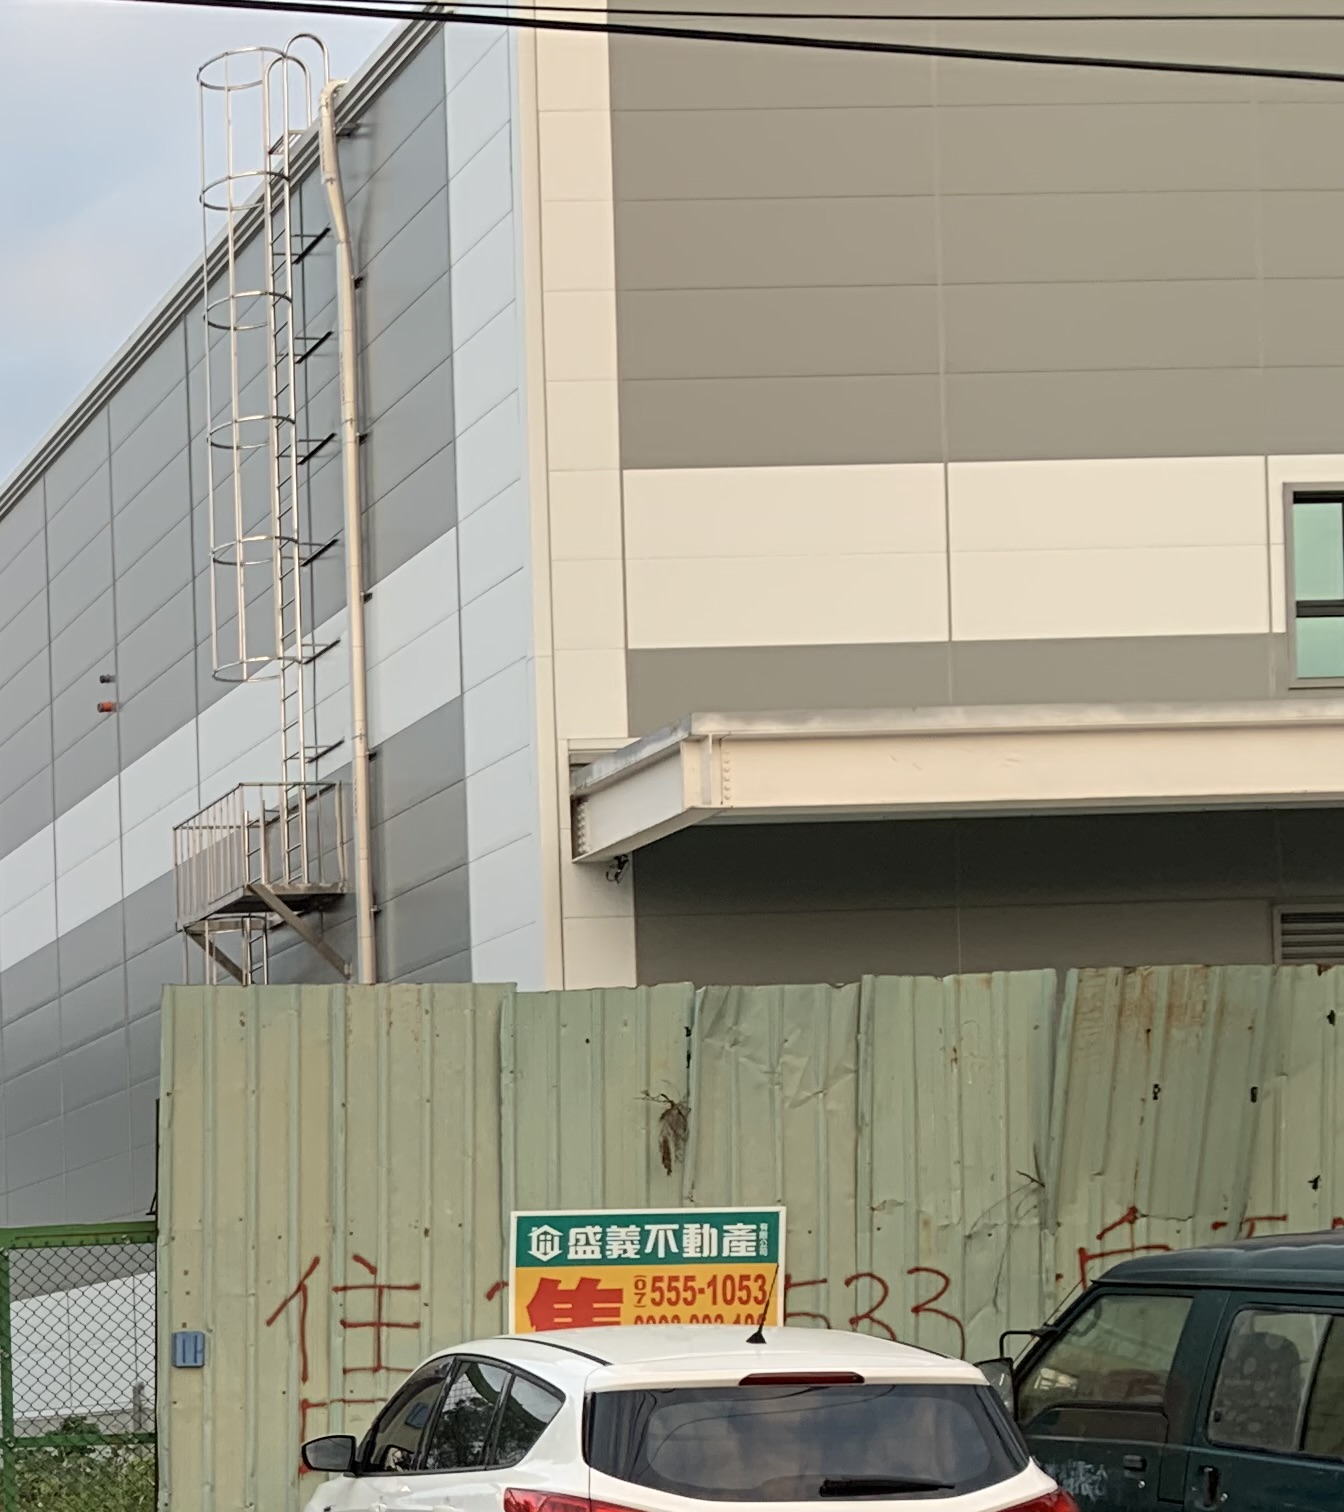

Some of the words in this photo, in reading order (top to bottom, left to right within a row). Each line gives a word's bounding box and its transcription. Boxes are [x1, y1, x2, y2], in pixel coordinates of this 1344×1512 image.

[567, 1223, 757, 1259] 盛義不動產
[650, 1274, 768, 1306] 555-1053
